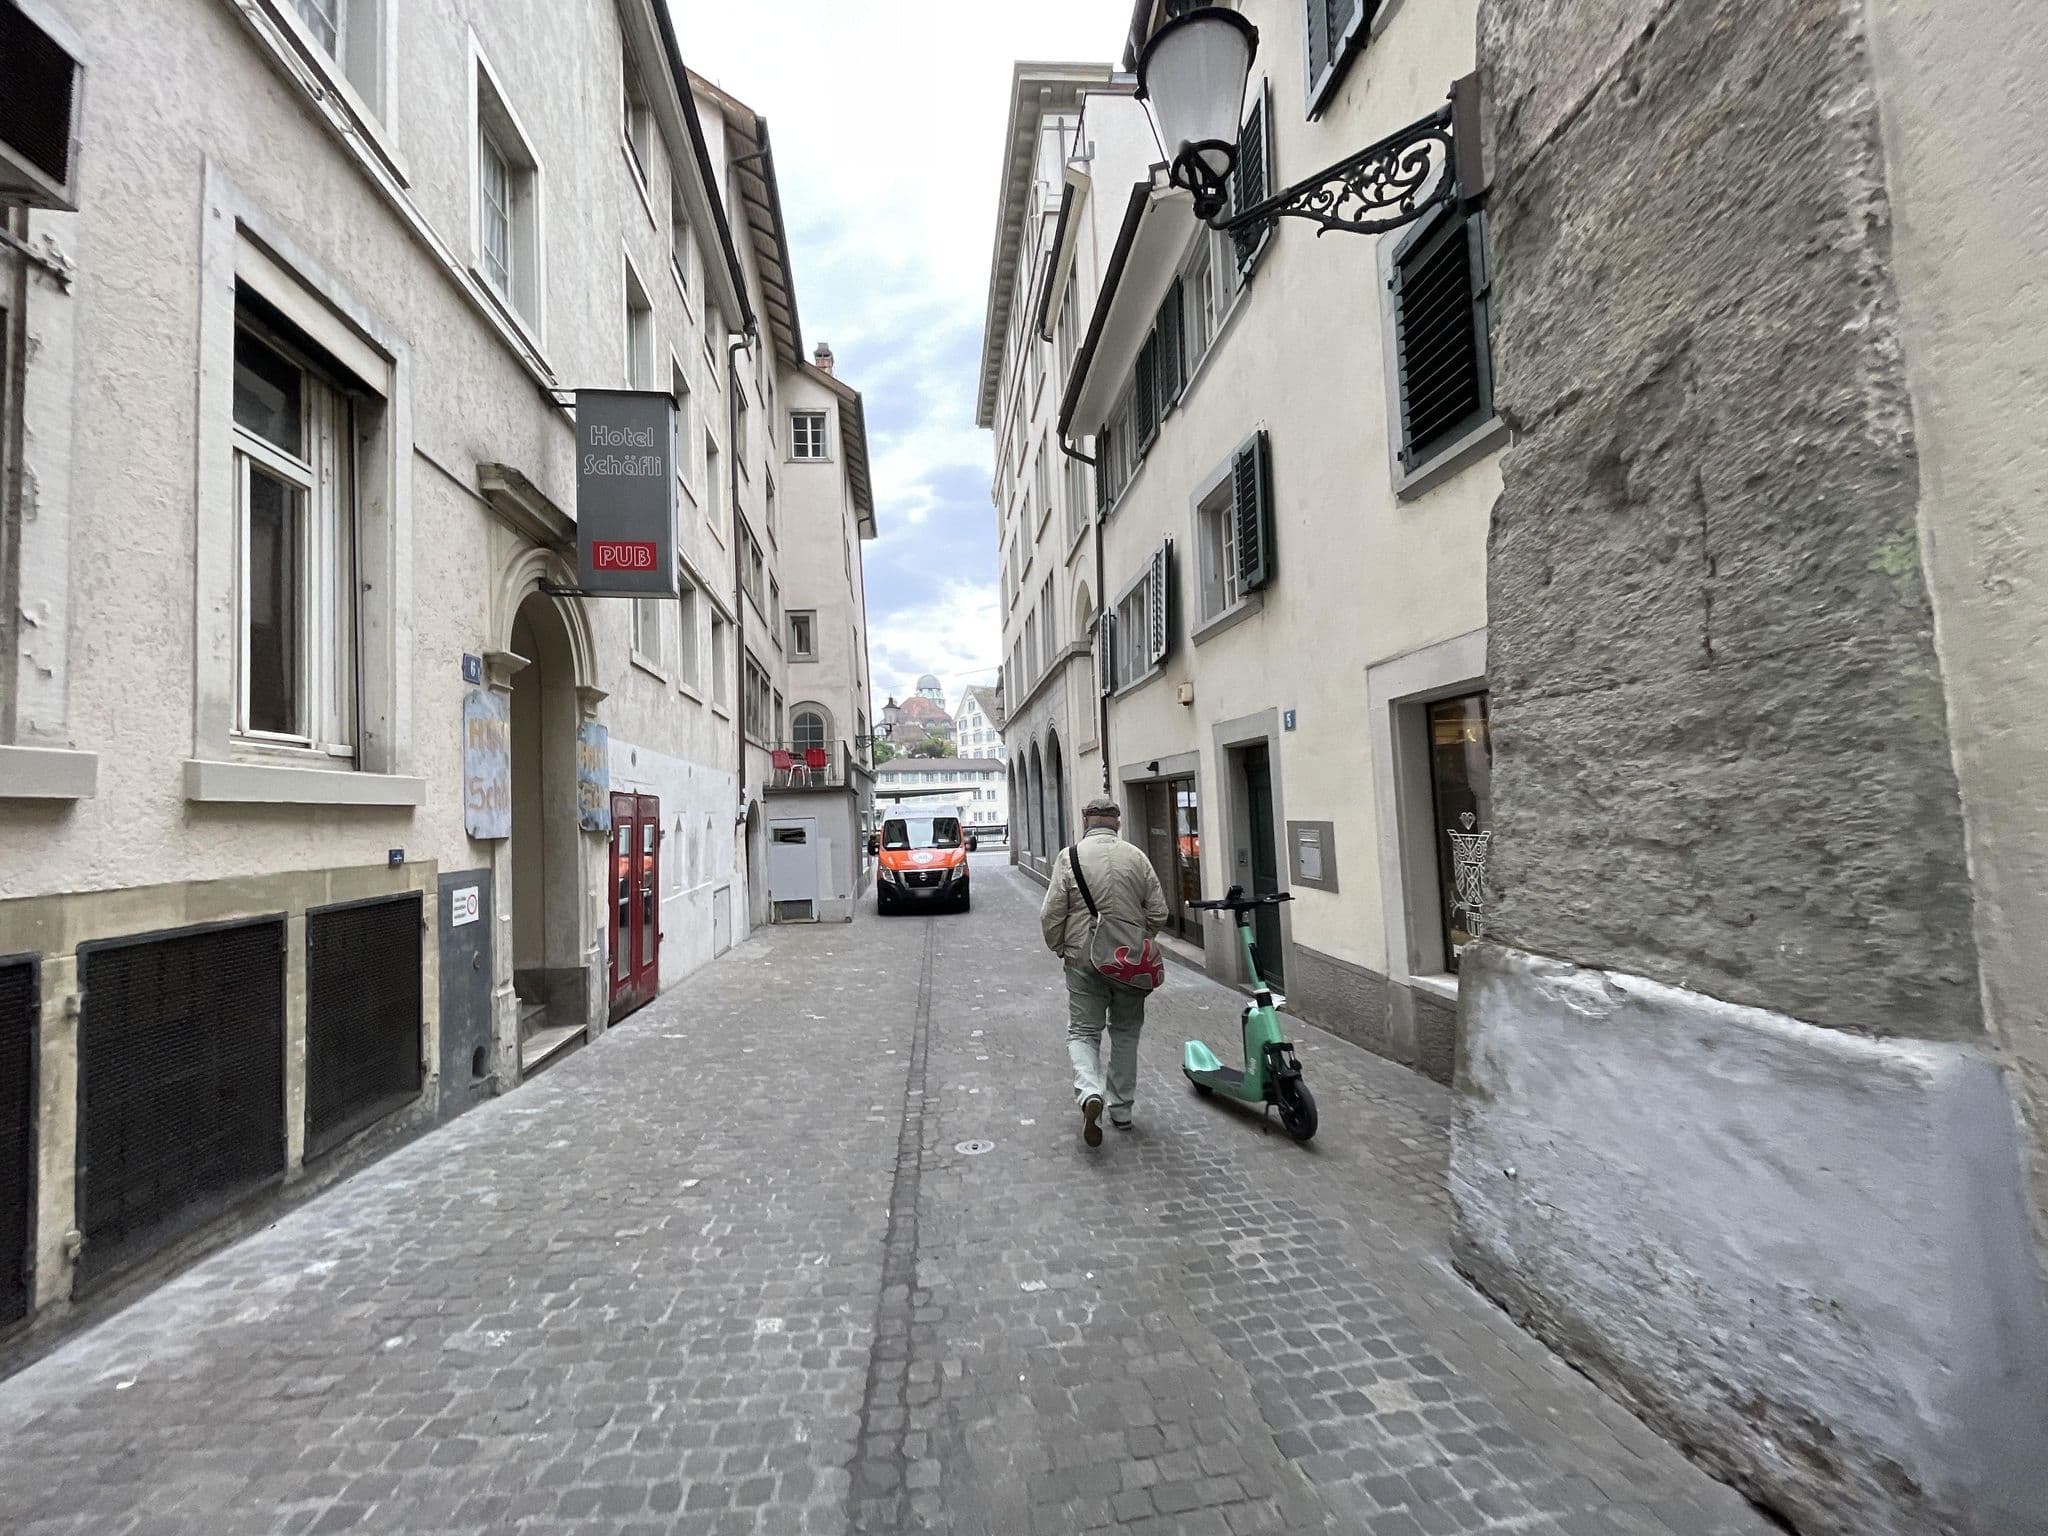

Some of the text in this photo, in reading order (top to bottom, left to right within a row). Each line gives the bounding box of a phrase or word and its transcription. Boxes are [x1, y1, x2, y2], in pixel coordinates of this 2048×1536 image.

[590, 424, 654, 447] Hotel
[584, 453, 662, 476] Schäfli
[599, 545, 651, 567] PUB
[470, 659, 476, 677] 6
